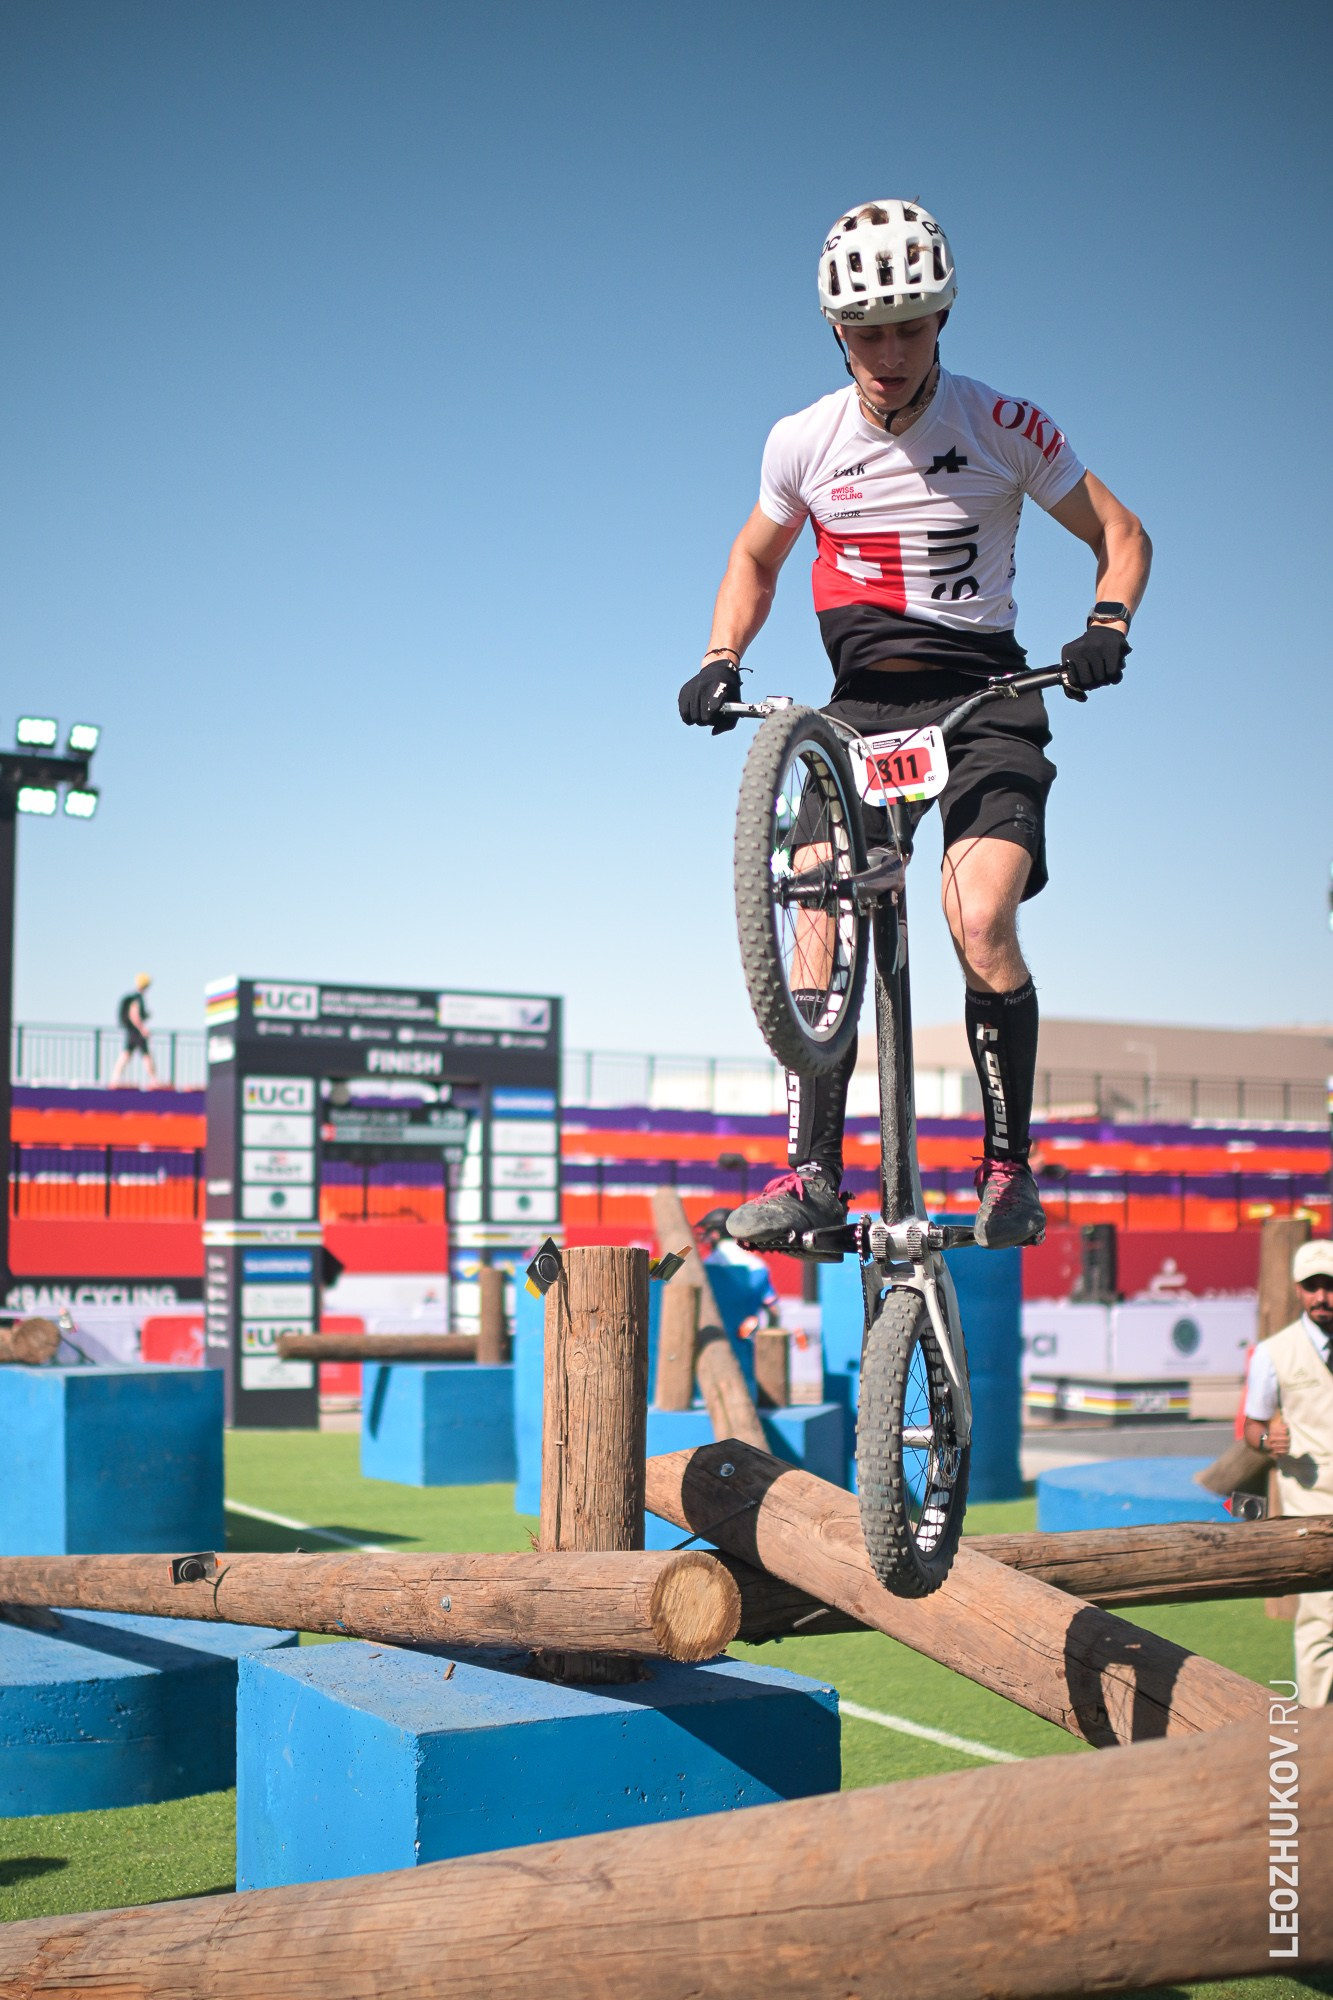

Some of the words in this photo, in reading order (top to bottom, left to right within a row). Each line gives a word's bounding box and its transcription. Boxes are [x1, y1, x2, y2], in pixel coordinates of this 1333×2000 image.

[831, 486, 855, 495] SWISS
[831, 492, 863, 501] CYCLING
[927, 524, 980, 600] SUI
[265, 991, 312, 1011] UCI
[795, 994, 826, 1003] heb
[367, 1049, 442, 1075] FINISH
[258, 1086, 305, 1106] UCI
[787, 1071, 800, 1154] heb
